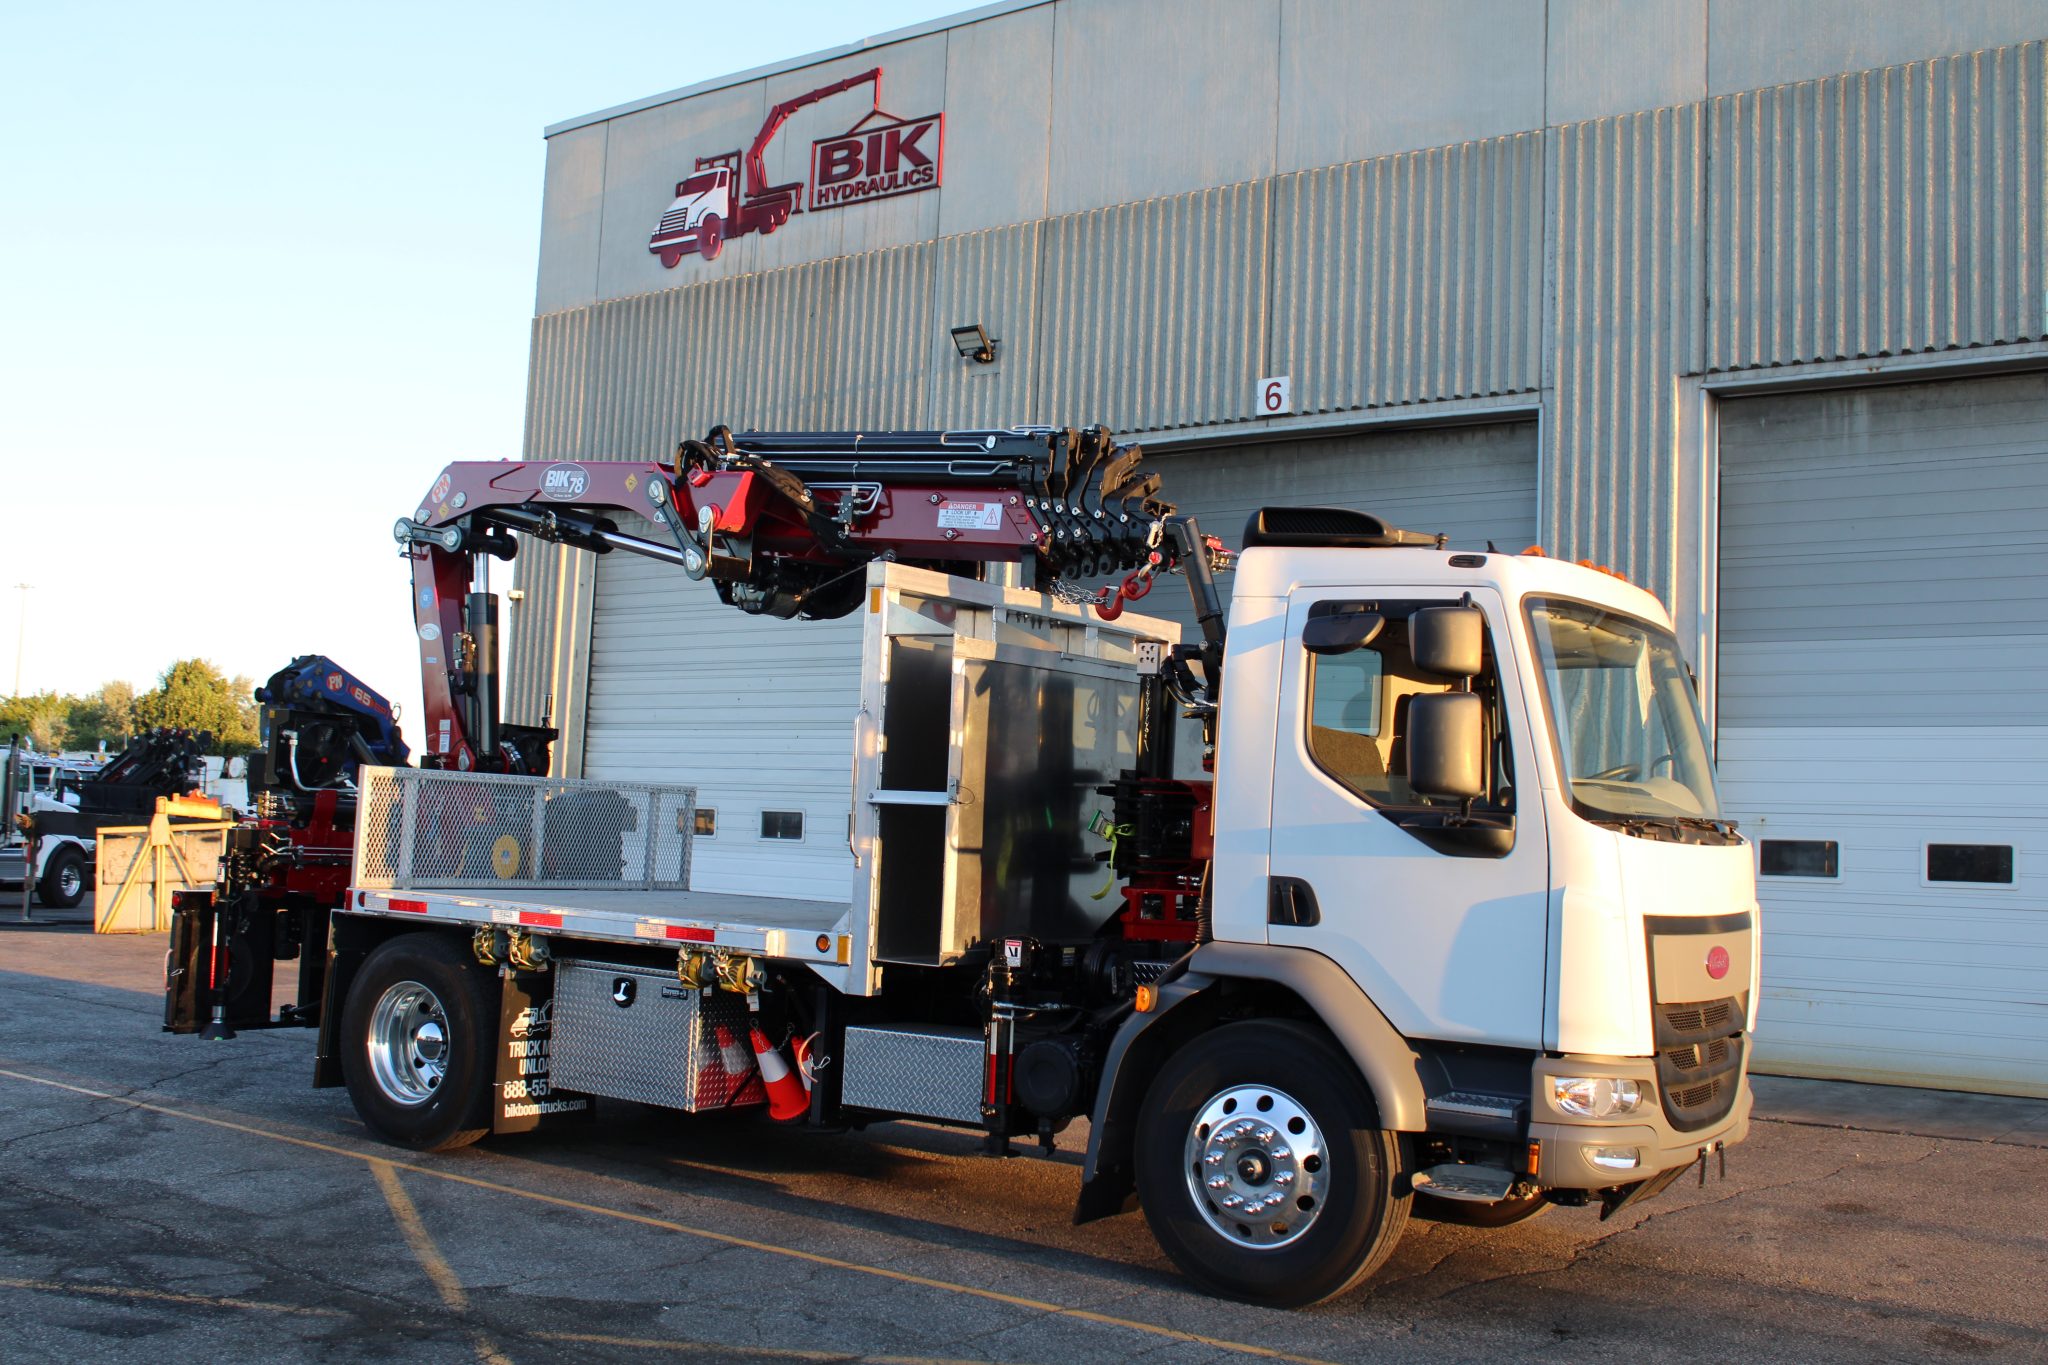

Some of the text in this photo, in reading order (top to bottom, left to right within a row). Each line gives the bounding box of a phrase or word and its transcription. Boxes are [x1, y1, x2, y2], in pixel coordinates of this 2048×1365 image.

[819, 122, 933, 186] BIK
[817, 166, 934, 204] HYDRAULICS
[1265, 382, 1282, 411] 6
[545, 470, 571, 487] BIK
[568, 477, 584, 493] 78
[328, 673, 343, 690] PM
[354, 687, 371, 706] 65
[509, 1040, 541, 1058] TRUCK
[504, 1099, 587, 1118] bikboomtrucks.com
